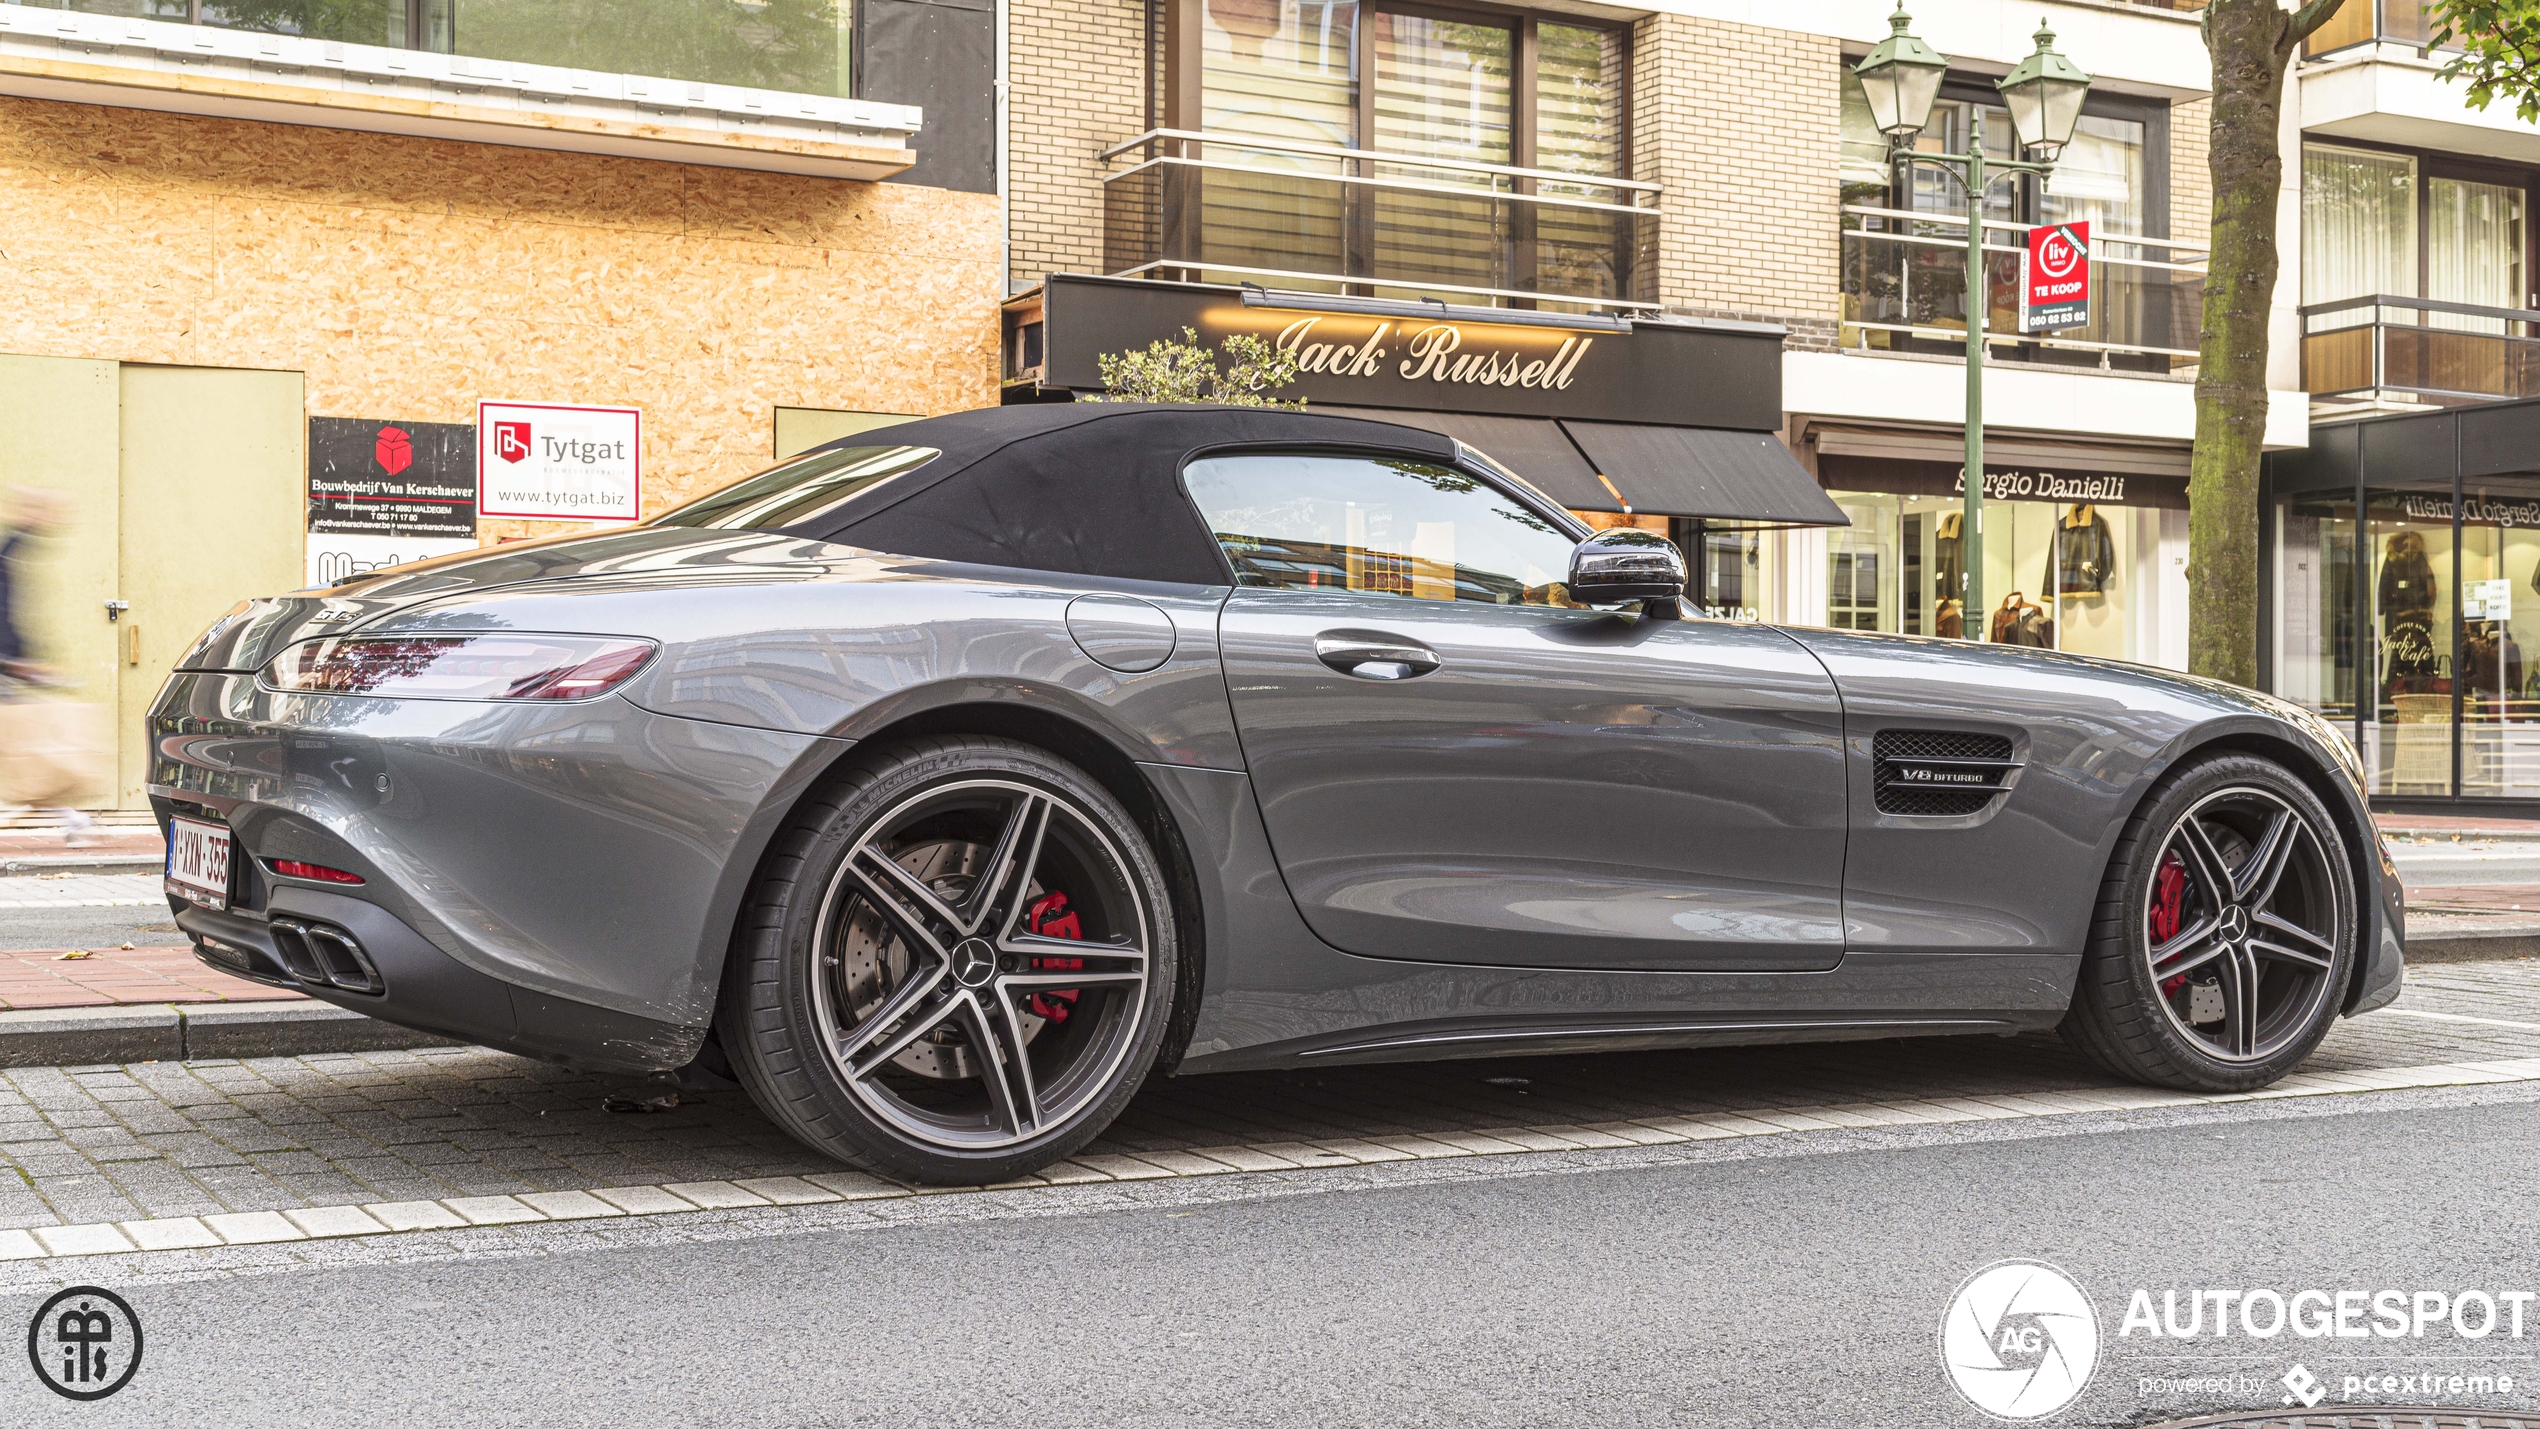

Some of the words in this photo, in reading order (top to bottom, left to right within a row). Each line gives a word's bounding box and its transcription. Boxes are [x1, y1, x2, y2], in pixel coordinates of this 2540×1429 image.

[2061, 226, 2087, 255] VERKOCHT
[2049, 243, 2069, 260] liv
[2034, 286, 2049, 297] TE
[2051, 281, 2082, 296] KOOP
[2030, 316, 2046, 326] 050
[2048, 314, 2060, 324] 62
[2074, 311, 2086, 321] 62
[1250, 317, 1391, 391] Jack
[1400, 324, 1593, 390] Russell
[541, 436, 625, 464] Tytgat
[312, 479, 380, 496] Bouwbedrijf
[381, 481, 404, 495] Van
[406, 483, 474, 497] Kerschaever
[1955, 467, 2032, 499] Srgio
[2034, 472, 2125, 500] Danielli
[498, 491, 625, 507] www.tytgat.biz
[377, 513, 389, 521] 050
[390, 513, 398, 521] 71
[409, 514, 418, 522] 80
[395, 505, 411, 513] 9990
[413, 506, 452, 514] MALDEGEM
[315, 519, 390, 529] info@vankerschaever.be
[397, 523, 471, 532] www.vankerschaever.be
[2378, 632, 2419, 656] Jack's
[2400, 645, 2433, 667] Café
[867, 758, 938, 803] MICHELIN
[1902, 769, 1931, 781] V8
[1934, 773, 1983, 782] BITURBO
